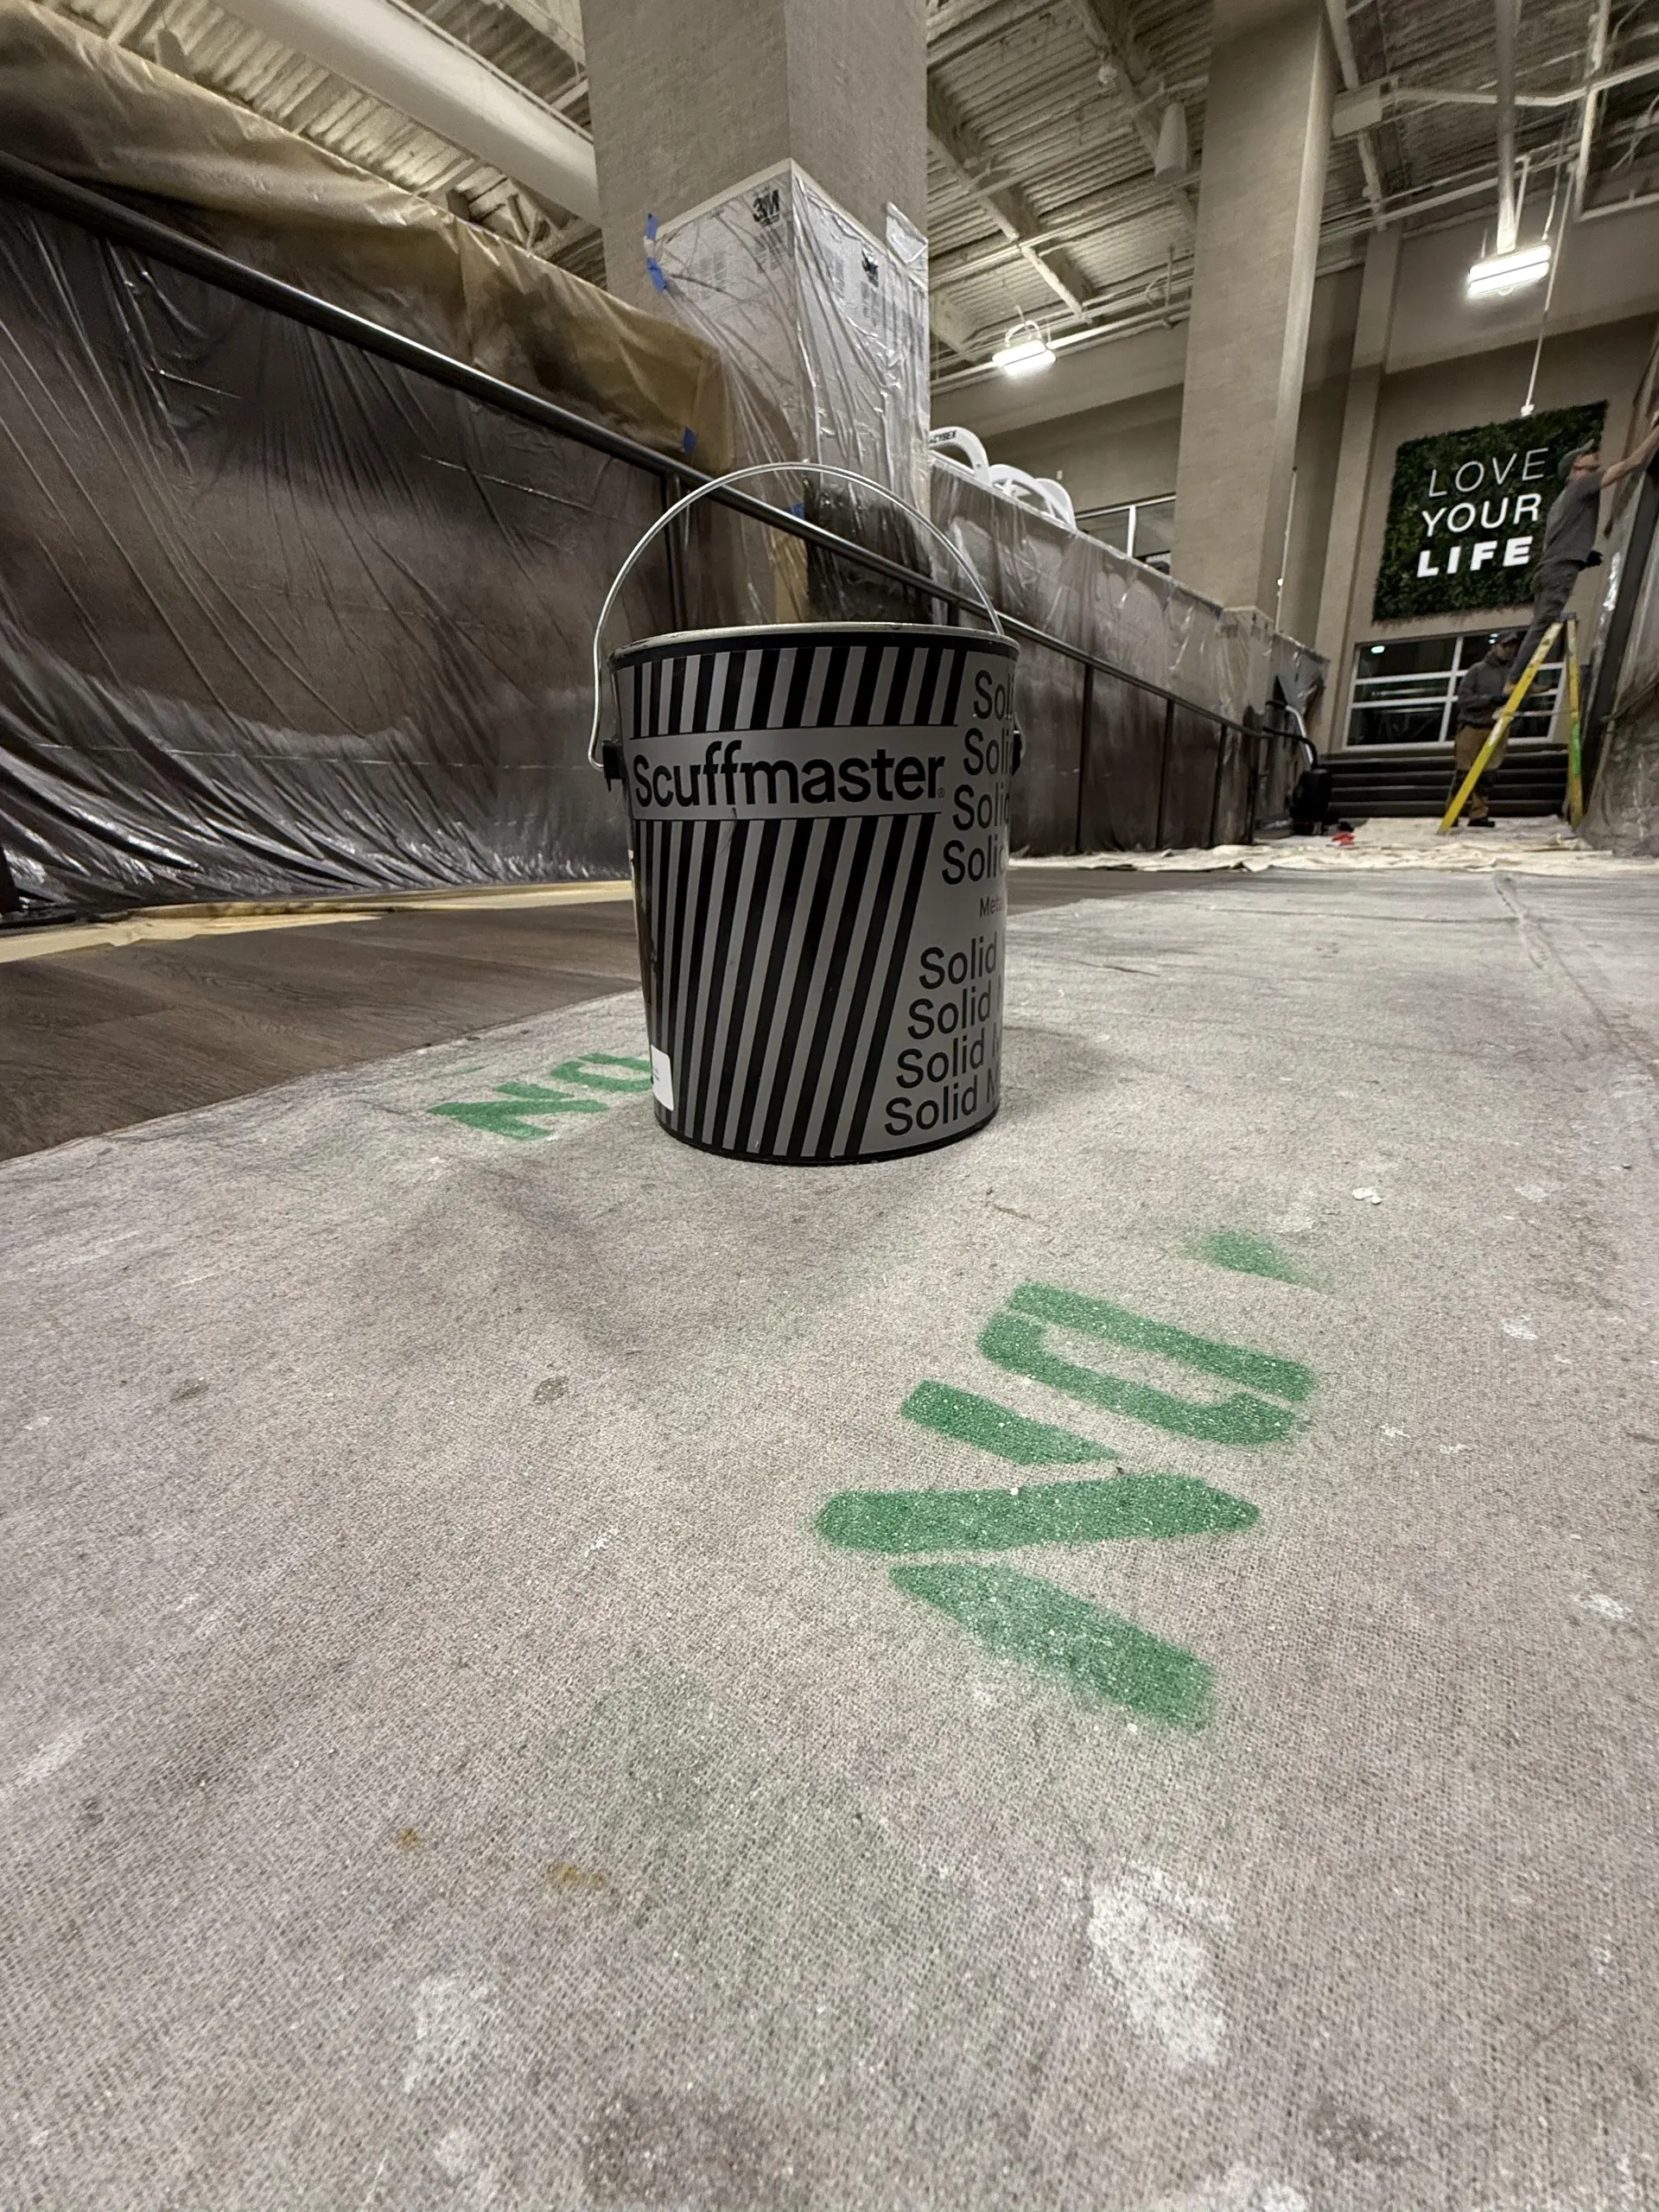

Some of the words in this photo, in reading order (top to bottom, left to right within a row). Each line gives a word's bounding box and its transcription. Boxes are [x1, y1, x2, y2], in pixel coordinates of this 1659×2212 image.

[1428, 448, 1549, 498] LOVE
[1421, 493, 1541, 537] YOUR
[1416, 536, 1534, 578] LIFE
[633, 741, 946, 808] Scuffmaster
[918, 931, 998, 990] Solid
[907, 980, 992, 1040] Solid
[896, 1027, 986, 1090] Solid
[885, 1074, 978, 1136] Solid
